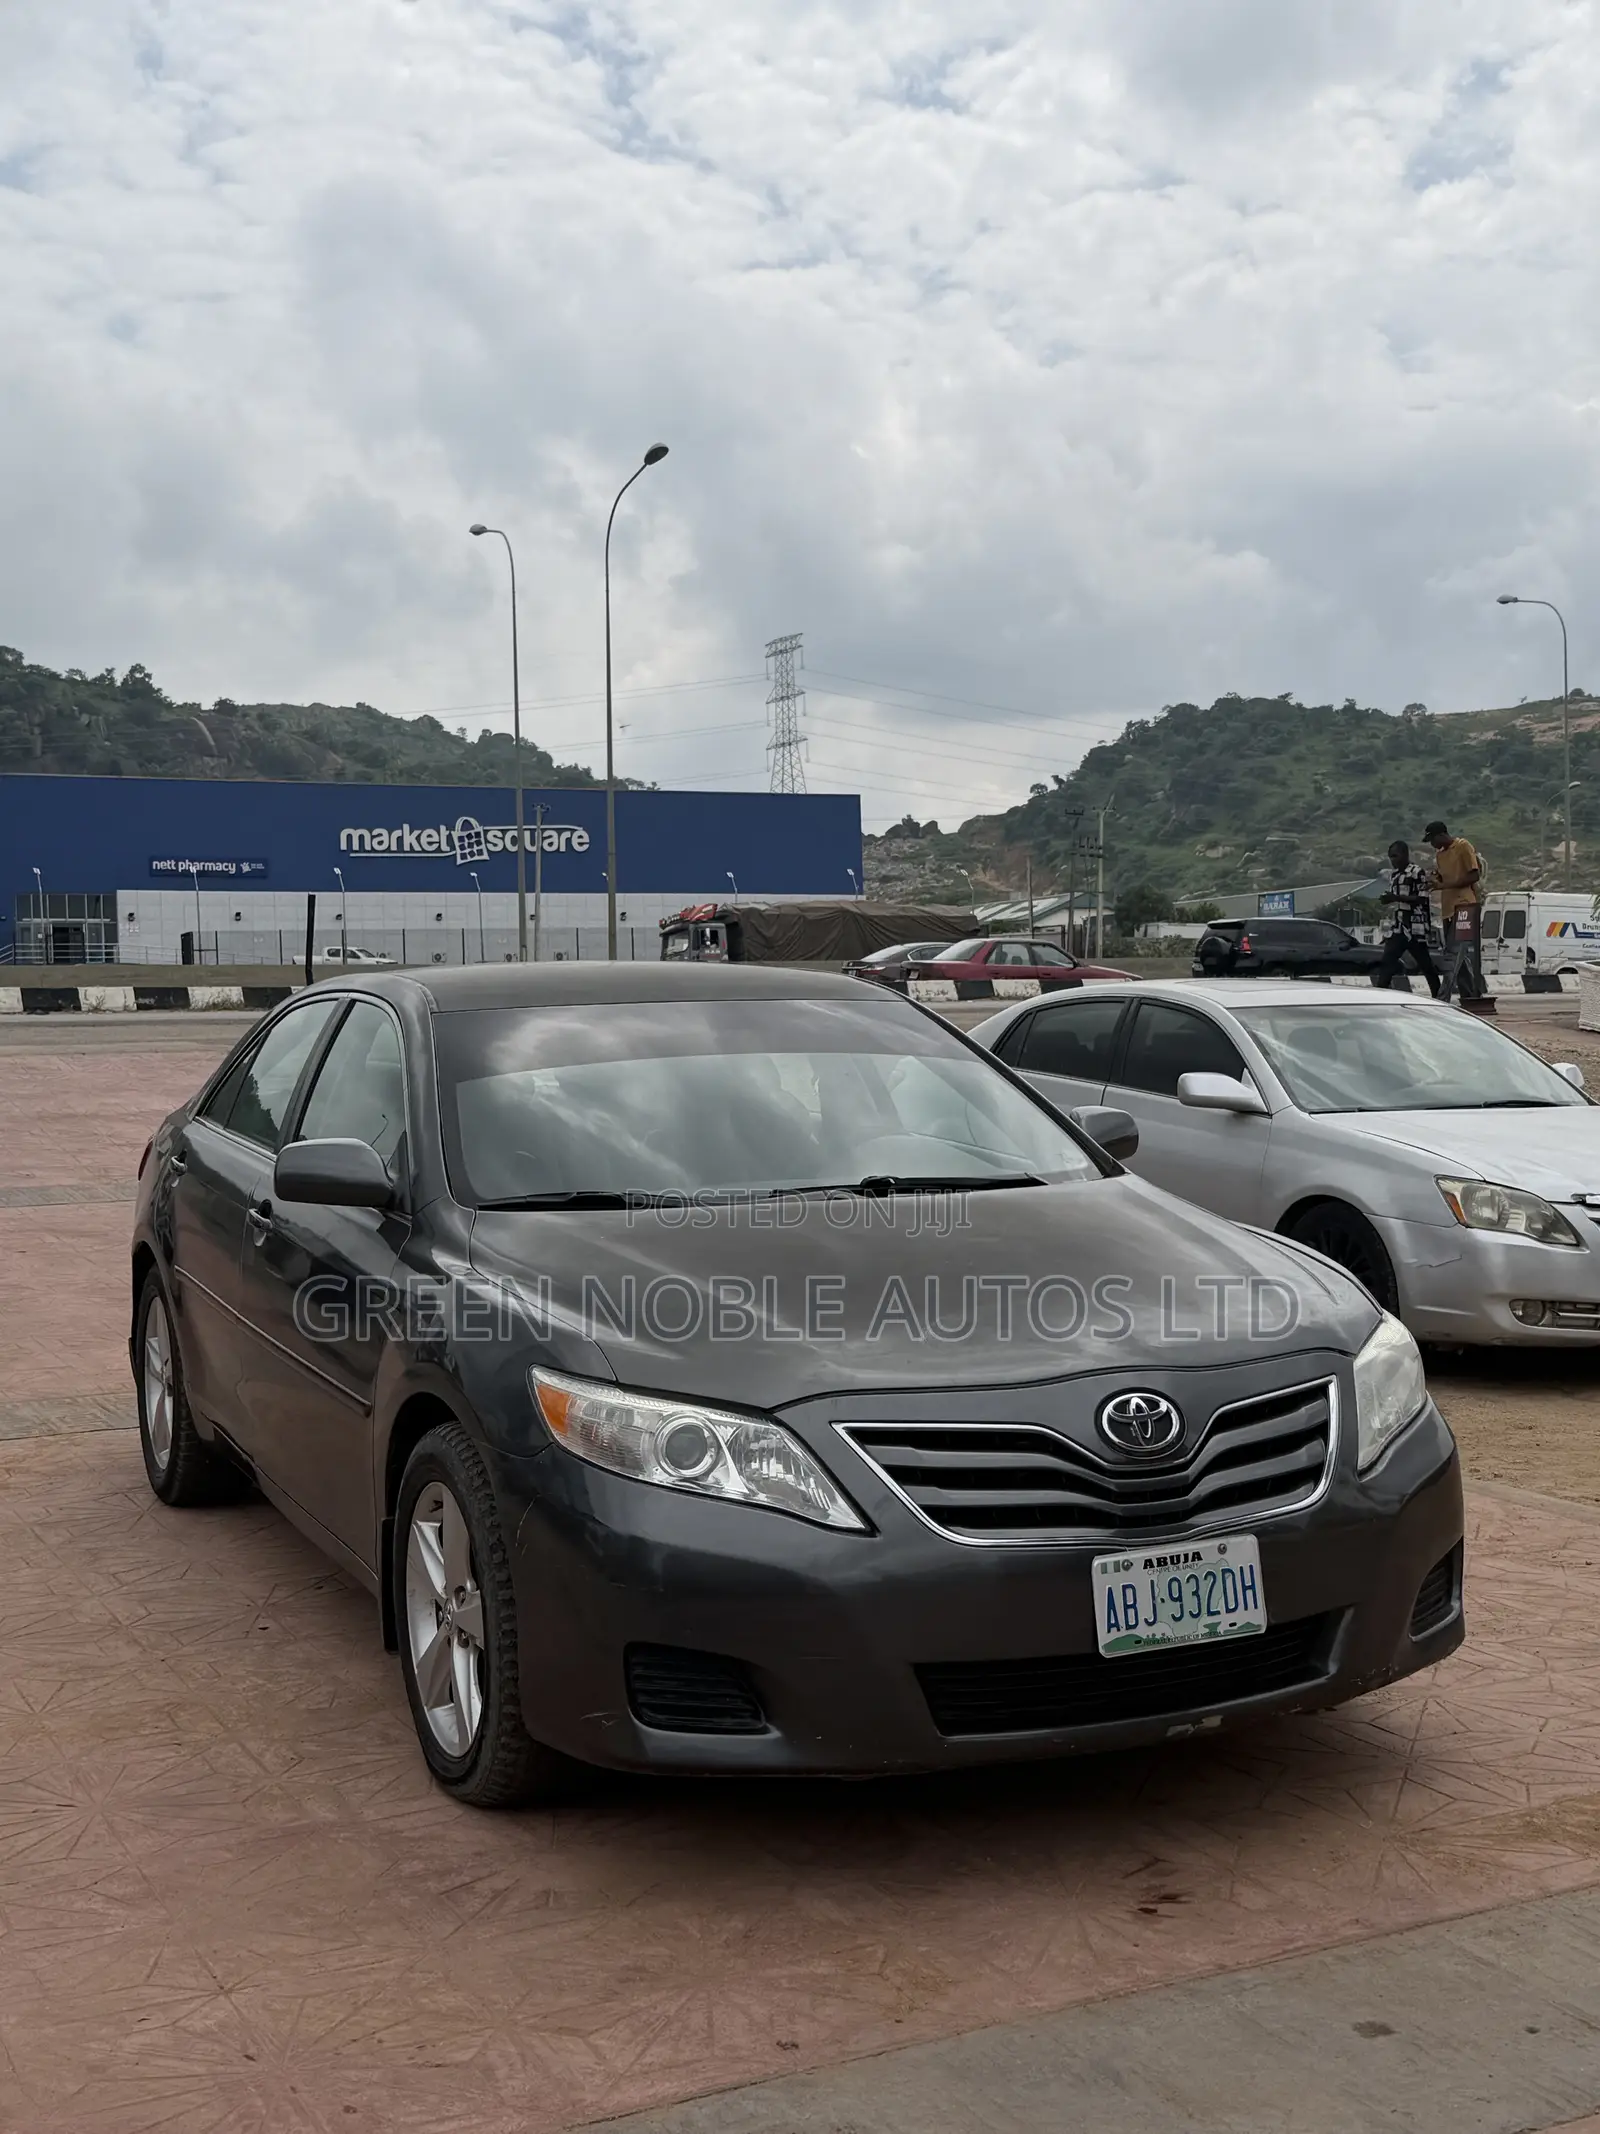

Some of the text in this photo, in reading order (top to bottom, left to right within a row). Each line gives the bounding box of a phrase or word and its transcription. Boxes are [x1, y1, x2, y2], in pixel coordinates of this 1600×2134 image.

[339, 823, 450, 852] market
[152, 859, 176, 870] nett
[178, 859, 236, 874] pharmacy
[1457, 910, 1468, 921] NO
[1142, 1551, 1204, 1570] ABUJA
